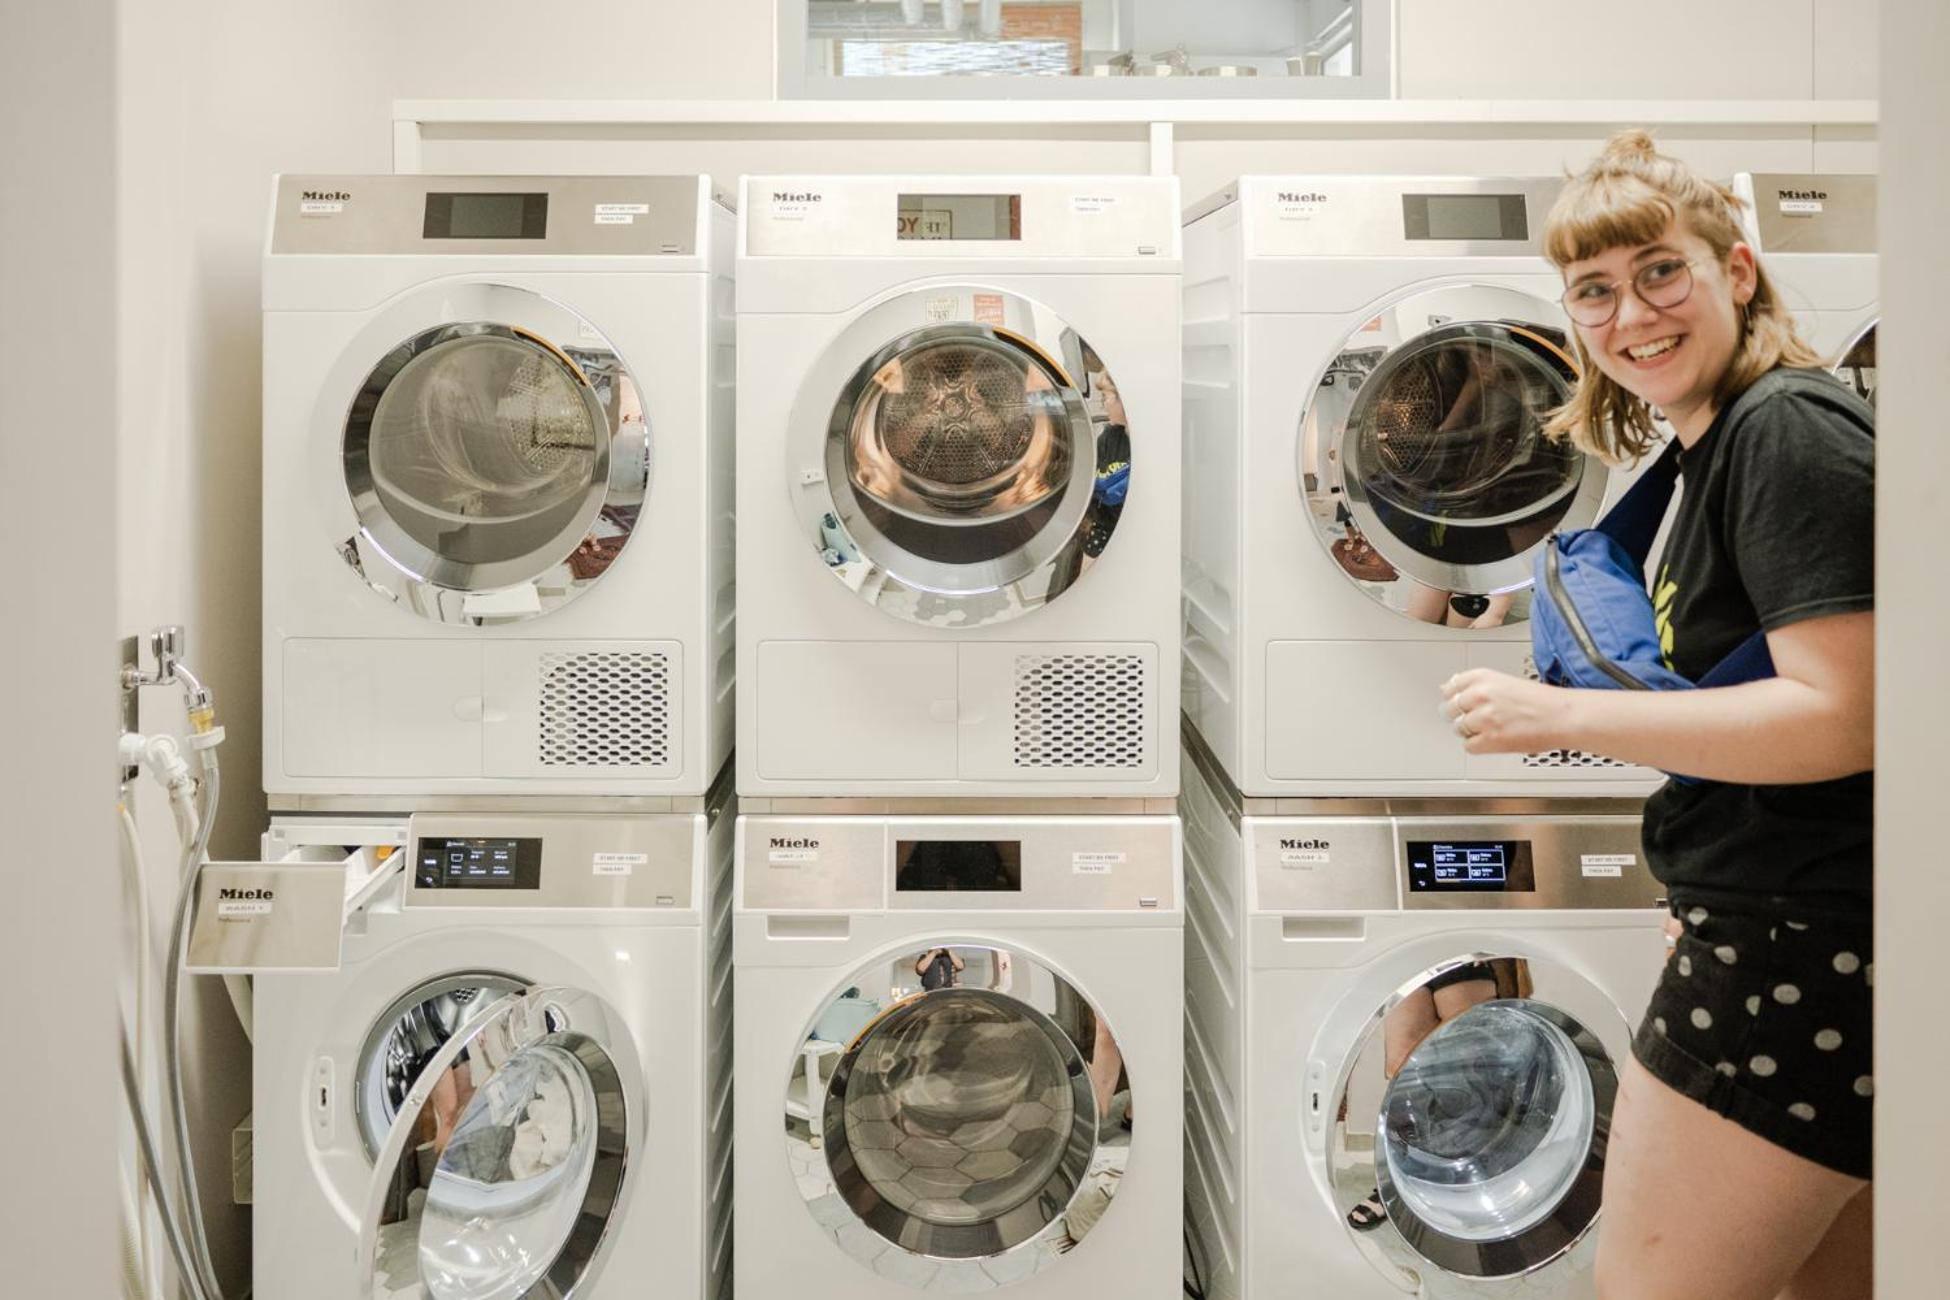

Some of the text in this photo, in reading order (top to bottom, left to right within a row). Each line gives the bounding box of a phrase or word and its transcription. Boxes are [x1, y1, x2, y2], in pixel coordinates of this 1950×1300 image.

[302, 191, 351, 201] Miele
[773, 192, 822, 202] Miele
[1278, 192, 1327, 202] Miele
[1778, 190, 1827, 200] Miele
[770, 838, 819, 848] Miele
[1280, 839, 1330, 850] Miele
[219, 888, 273, 900] Miele
